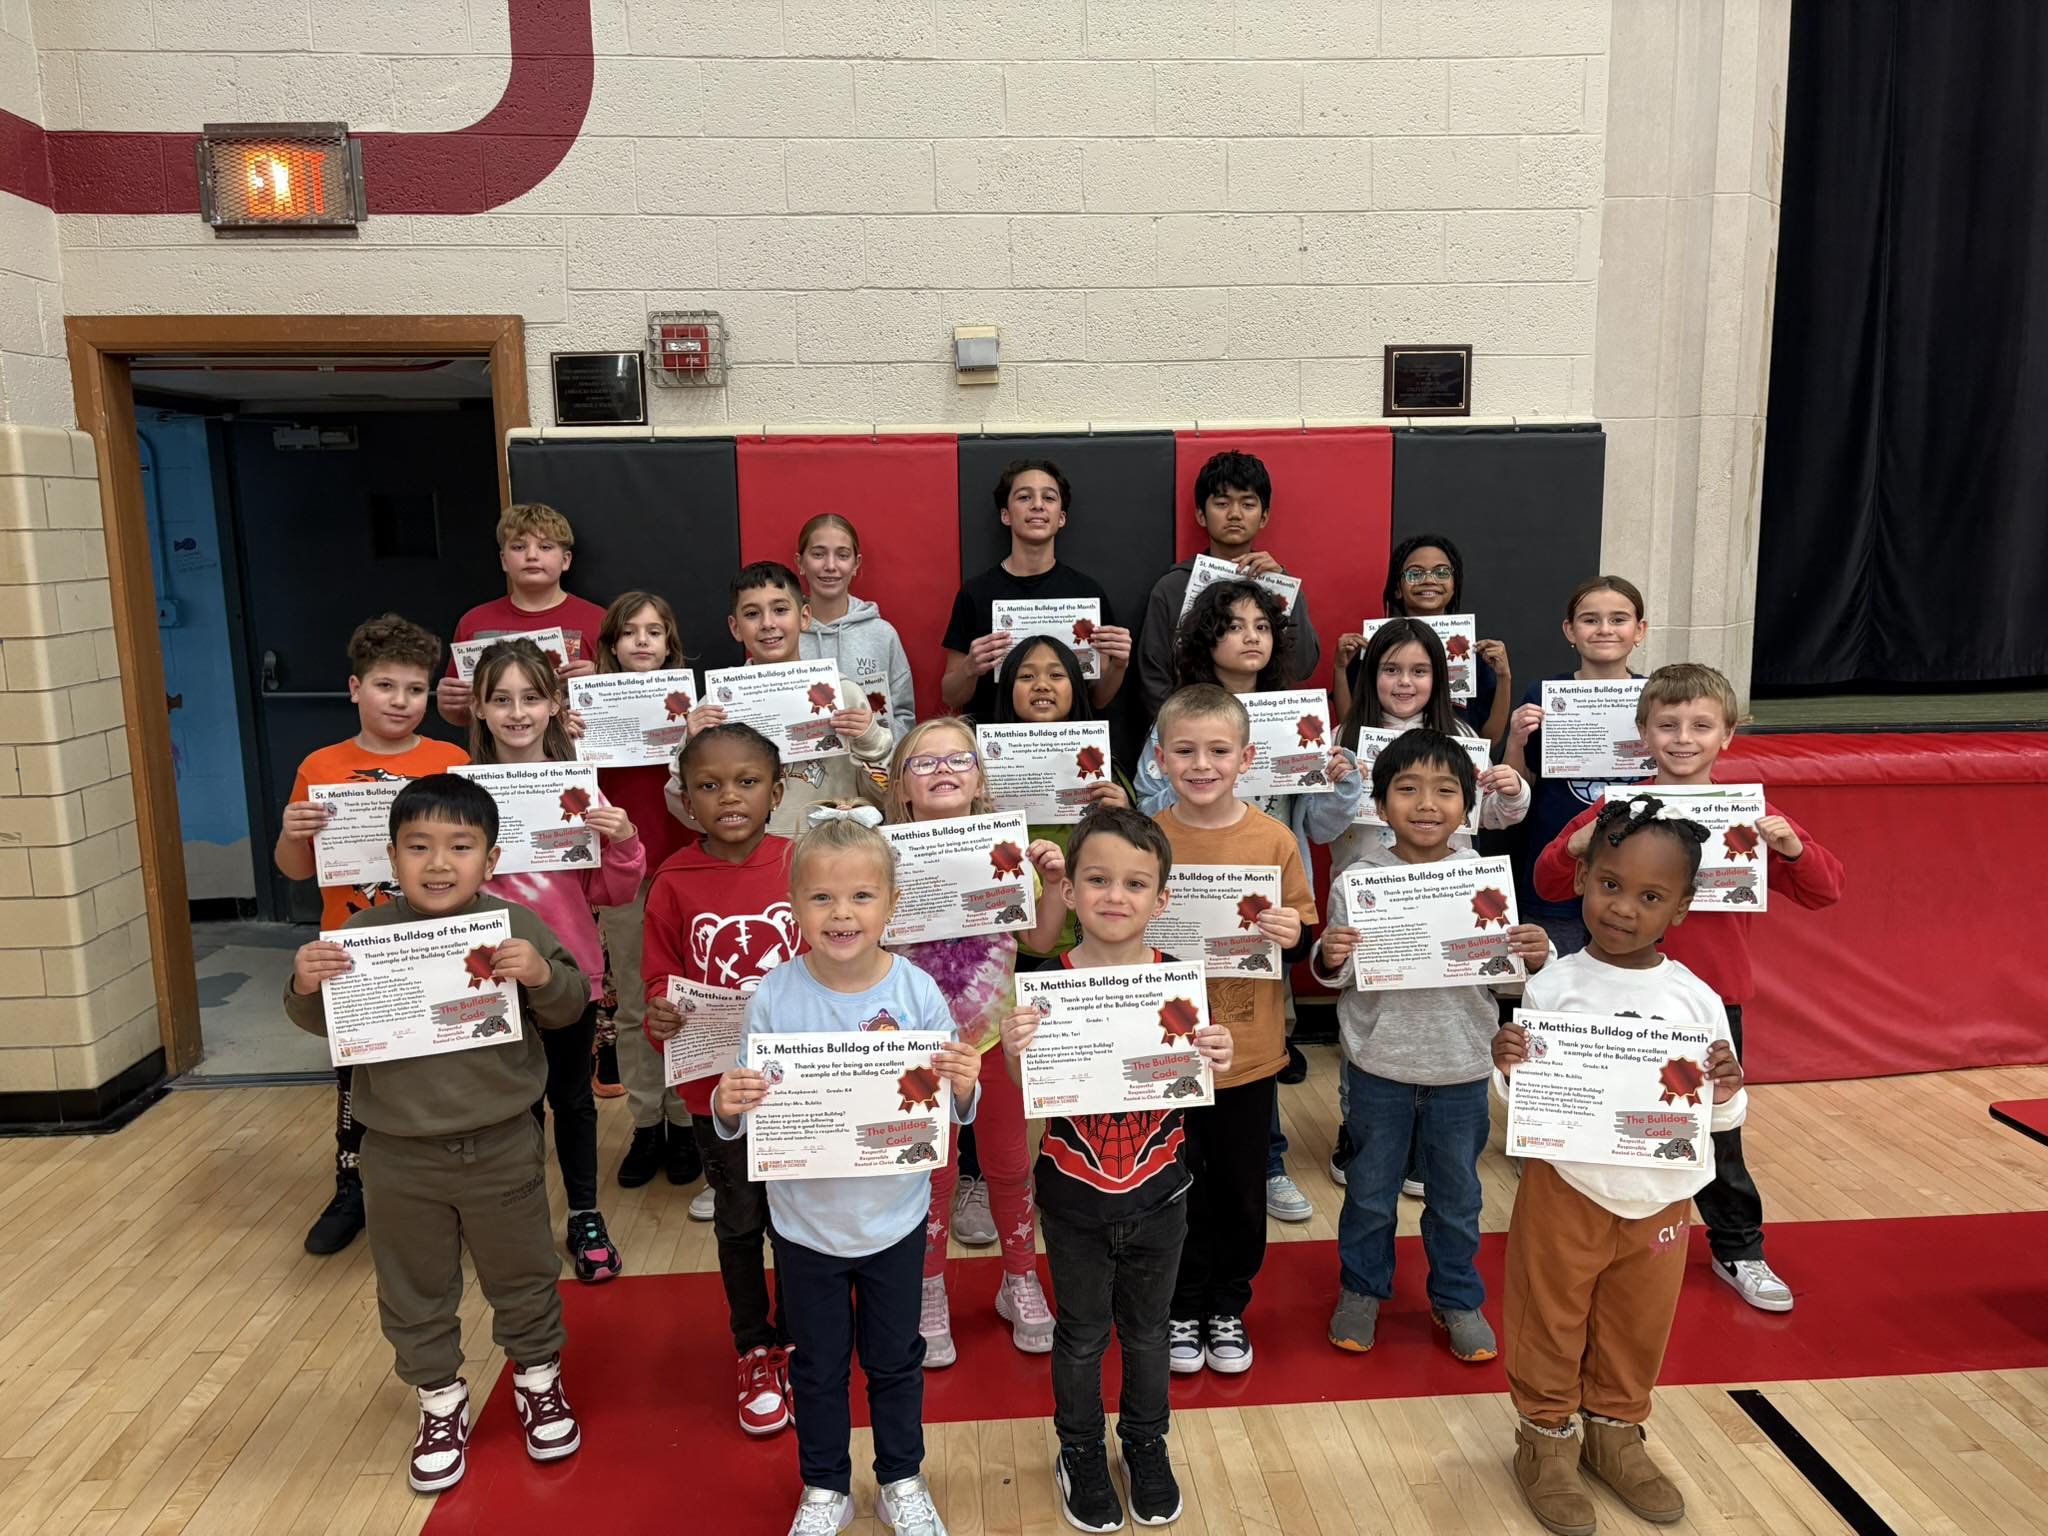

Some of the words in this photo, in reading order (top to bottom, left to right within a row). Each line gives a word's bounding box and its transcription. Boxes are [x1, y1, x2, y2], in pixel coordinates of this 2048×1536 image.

[1209, 564, 1234, 574] Matthias
[1276, 579, 1295, 588] Month
[538, 632, 558, 641] Month
[856, 658, 876, 668] WIS
[724, 674, 756, 682] Matthias
[758, 671, 786, 679] Bulldog
[810, 665, 832, 673] Month
[585, 681, 616, 689] Matthias
[1594, 686, 1622, 694] Bulldog
[1029, 729, 1057, 737] Bulldog
[468, 772, 504, 780] Matthias
[506, 770, 537, 779] Bulldog
[540, 769, 548, 777] of
[565, 768, 591, 776] Month
[328, 790, 365, 798] Matthias
[1703, 804, 1712, 812] of
[1715, 804, 1728, 812] the
[1731, 804, 1759, 812] Month
[892, 830, 930, 840] Matthias
[932, 827, 964, 836] Bulldog
[968, 824, 976, 832] of
[978, 823, 991, 831] the
[994, 819, 1020, 829] Month
[1179, 873, 1213, 882] Bulldog
[1228, 873, 1242, 881] the
[1351, 877, 1363, 886] St.
[1366, 874, 1406, 884] Matthias
[1409, 871, 1444, 881] Bulldog
[1446, 868, 1456, 877] of
[1458, 868, 1472, 876] the
[1476, 864, 1504, 874] Month
[969, 894, 984, 902] The
[986, 889, 1016, 898] Bulldog
[985, 901, 1006, 909] Code
[343, 934, 391, 947] Matthias
[394, 930, 434, 941] Bulldog
[437, 926, 448, 936] of
[451, 924, 467, 934] the
[469, 919, 502, 931] Month
[1451, 942, 1465, 950] The
[1468, 938, 1502, 948] Bulldog
[1468, 950, 1490, 959] Code
[1024, 981, 1038, 991] St.
[1041, 979, 1086, 990] Matthias
[1089, 976, 1129, 987] Bulldog
[1133, 974, 1143, 984] of
[1146, 974, 1162, 983] the
[1165, 971, 1198, 982] Month
[675, 984, 686, 994] St.
[689, 988, 733, 1000] Matthias
[1106, 993, 1122, 1001] being
[440, 1003, 458, 1013] The
[460, 996, 496, 1009] Bulldog
[1067, 1003, 1093, 1011] example
[460, 1010, 485, 1020] Code
[1522, 1019, 1536, 1030] St.
[1539, 1021, 1587, 1034] Matthias
[1591, 1025, 1632, 1039] Bulldog
[1636, 1029, 1647, 1038] of
[1651, 1029, 1668, 1040] the
[1672, 1031, 1708, 1043] Month
[757, 1044, 771, 1054] St.
[774, 1043, 824, 1054] Matthias
[827, 1042, 870, 1054] Bulldog
[873, 1041, 884, 1051] of
[887, 1041, 904, 1051] the
[1558, 1039, 1577, 1047] Thank
[1607, 1043, 1624, 1052] being
[844, 1061, 860, 1069] being
[1133, 1061, 1150, 1070] The
[1153, 1056, 1190, 1068] Bulldog
[1152, 1069, 1177, 1080] Code
[1625, 1115, 1645, 1124] The
[1648, 1115, 1687, 1125] Bulldog
[865, 1126, 885, 1136] The
[888, 1122, 927, 1133] Bulldog
[1645, 1128, 1672, 1136] Code
[887, 1135, 912, 1145] Code
